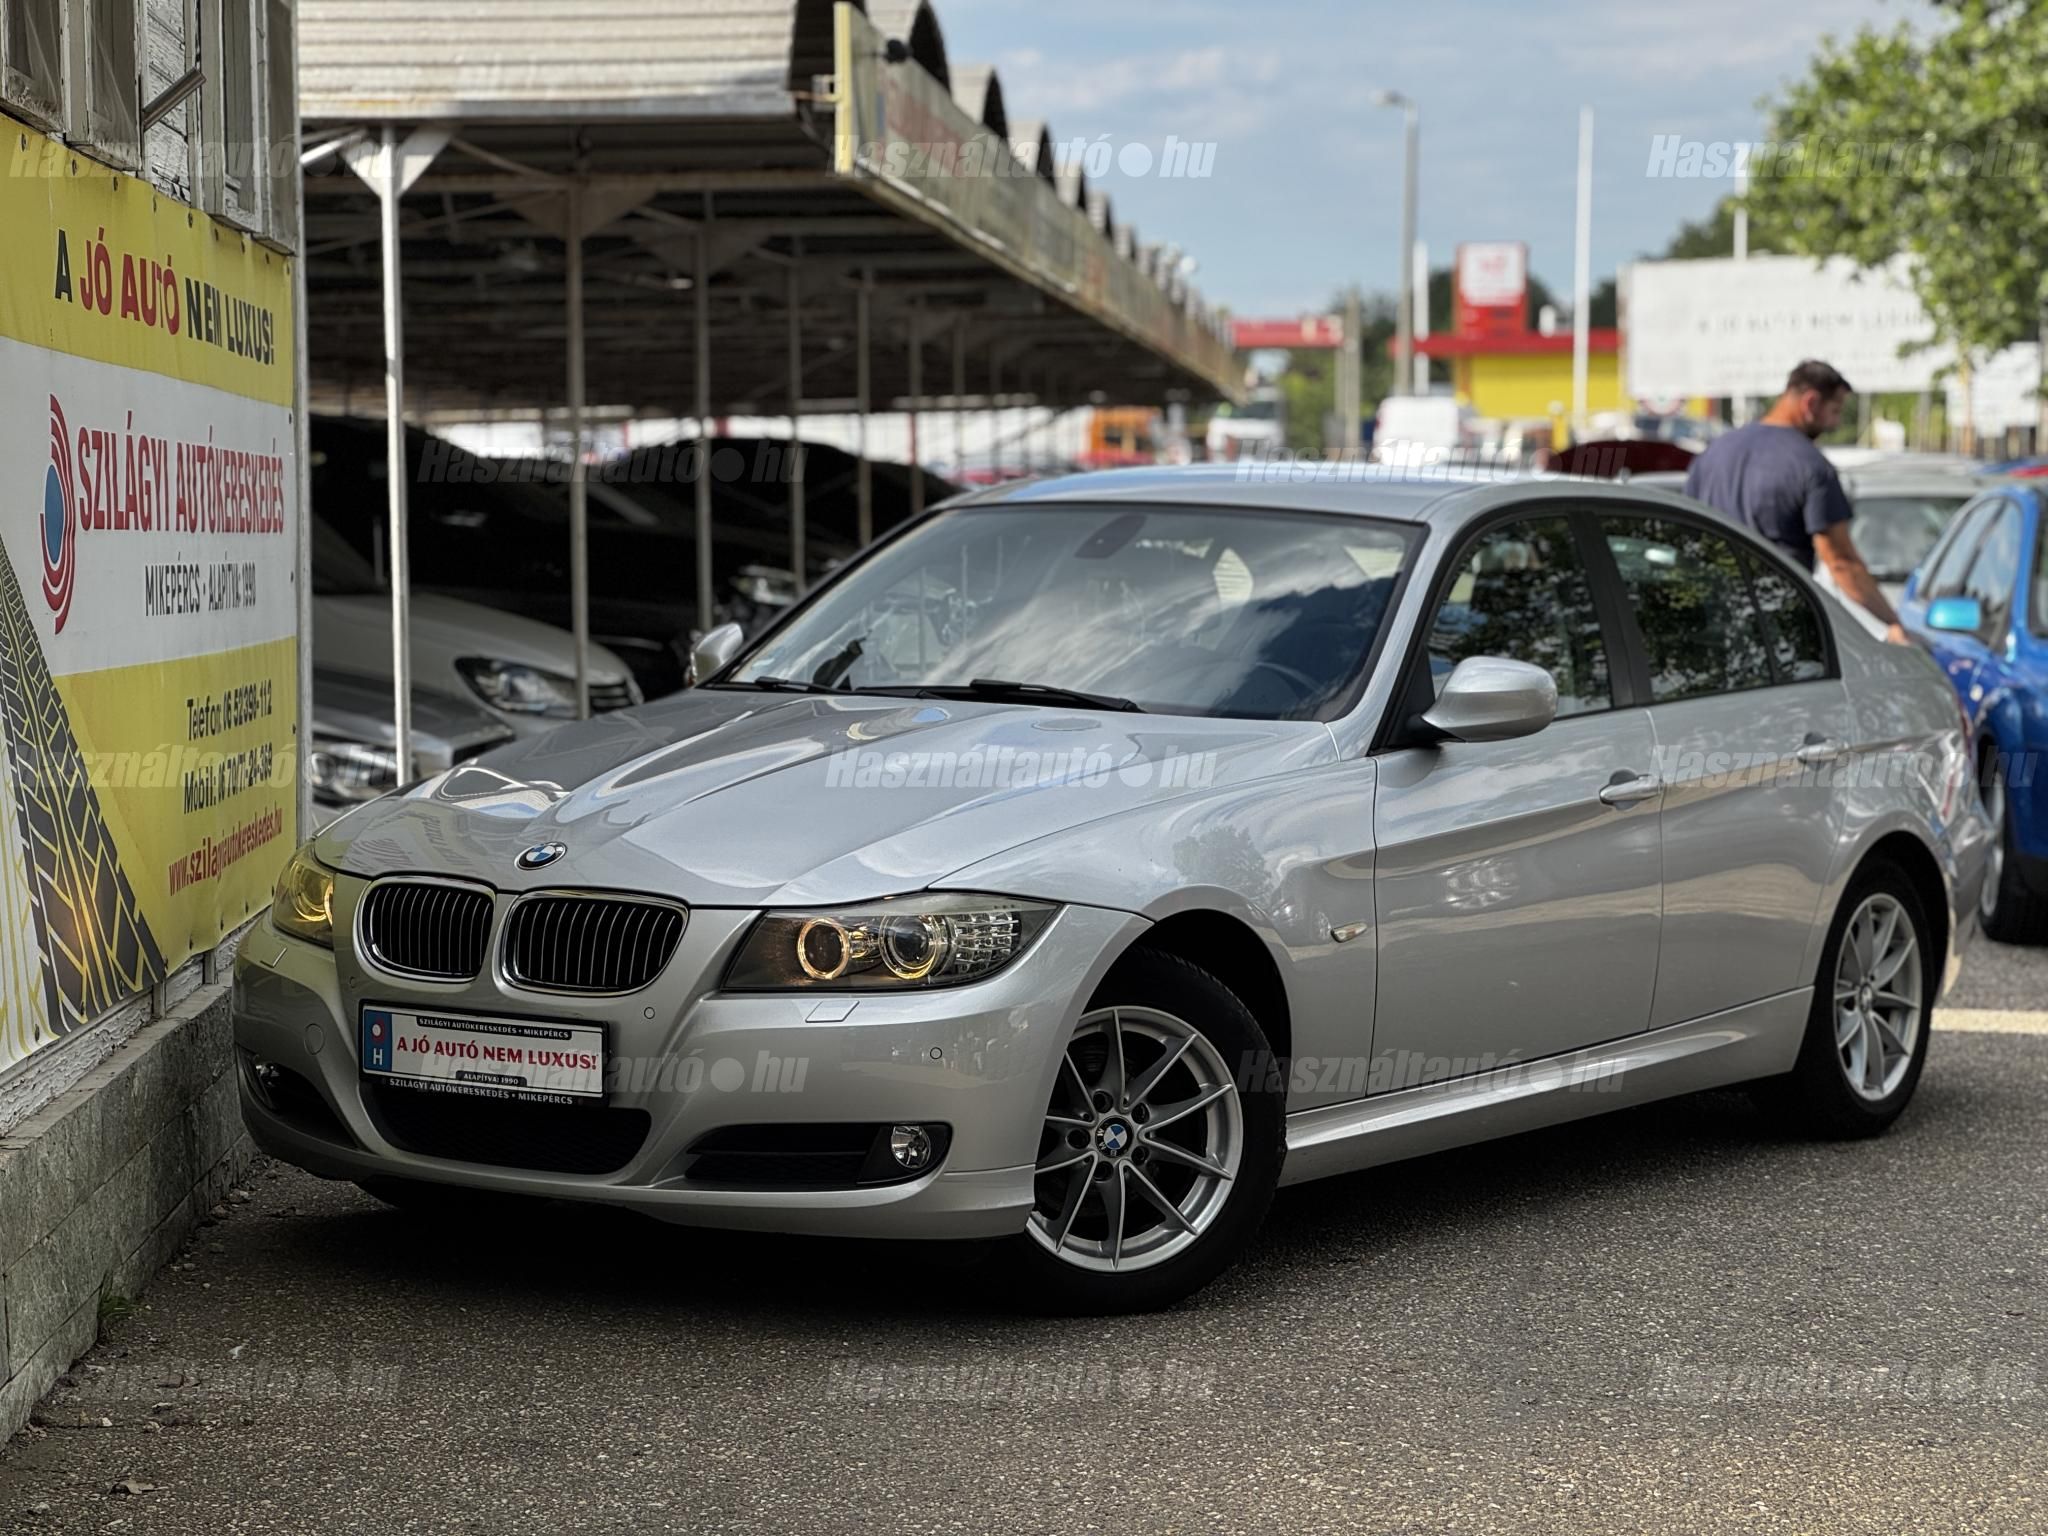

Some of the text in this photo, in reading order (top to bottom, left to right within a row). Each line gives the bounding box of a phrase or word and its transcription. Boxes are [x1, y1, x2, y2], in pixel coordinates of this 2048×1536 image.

[54, 227, 274, 366] A JÓ AUTÓ NEM LUXUS!
[77, 410, 285, 535] SZILÁGYI AUTÓKERESKEDÉS
[145, 551, 201, 617] MIKEPÉRCS
[184, 765, 216, 815] Mobil:
[419, 1018, 569, 1038] SZILÁGYI AUTÓKERESKEDÉS MIKEPÉRCS
[373, 1048, 383, 1066] H
[397, 1035, 597, 1070] A JÓ AUTÓ NEM LUXUS!
[389, 1077, 573, 1105] SZILÁGYI AUTÓKERESKEDÉS MIKEPÉRCS
[463, 1073, 519, 1085] ALAPÍTVA: 1990
